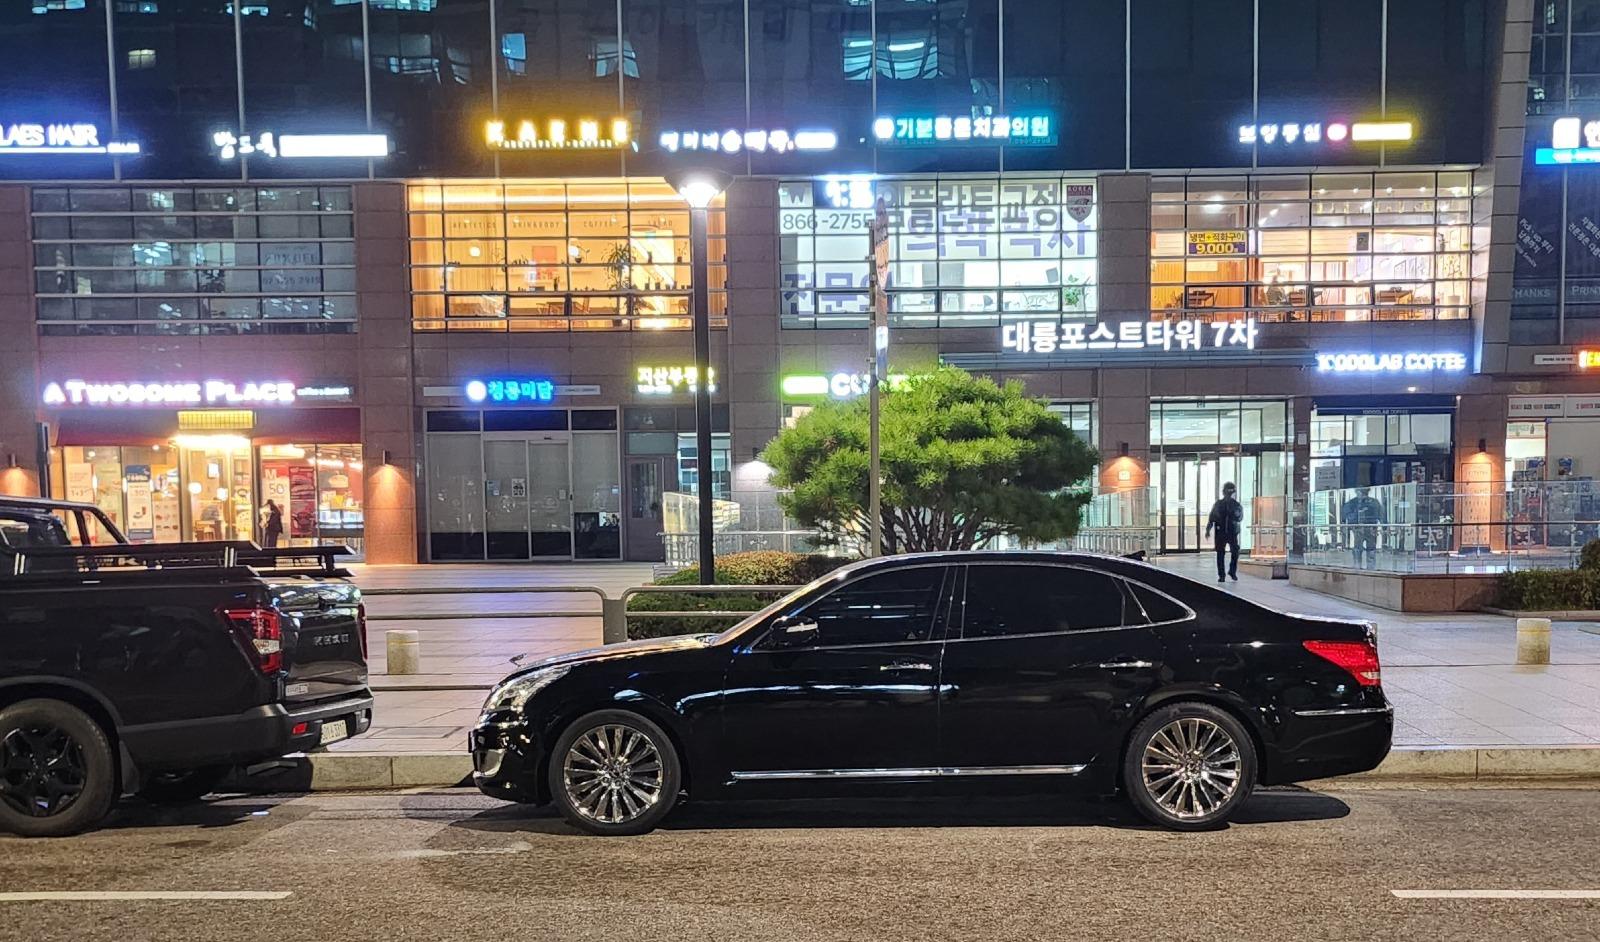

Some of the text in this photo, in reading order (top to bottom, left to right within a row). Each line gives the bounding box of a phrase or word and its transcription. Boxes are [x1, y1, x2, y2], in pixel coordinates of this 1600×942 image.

[1001, 183, 1059, 227] 교정
[1511, 287, 1551, 299] HANKS
[1002, 318, 1259, 353] 대륭포스트타워 7차
[1404, 352, 1467, 371] COFFEE
[43, 382, 65, 402] A
[205, 379, 296, 402] PLACE
